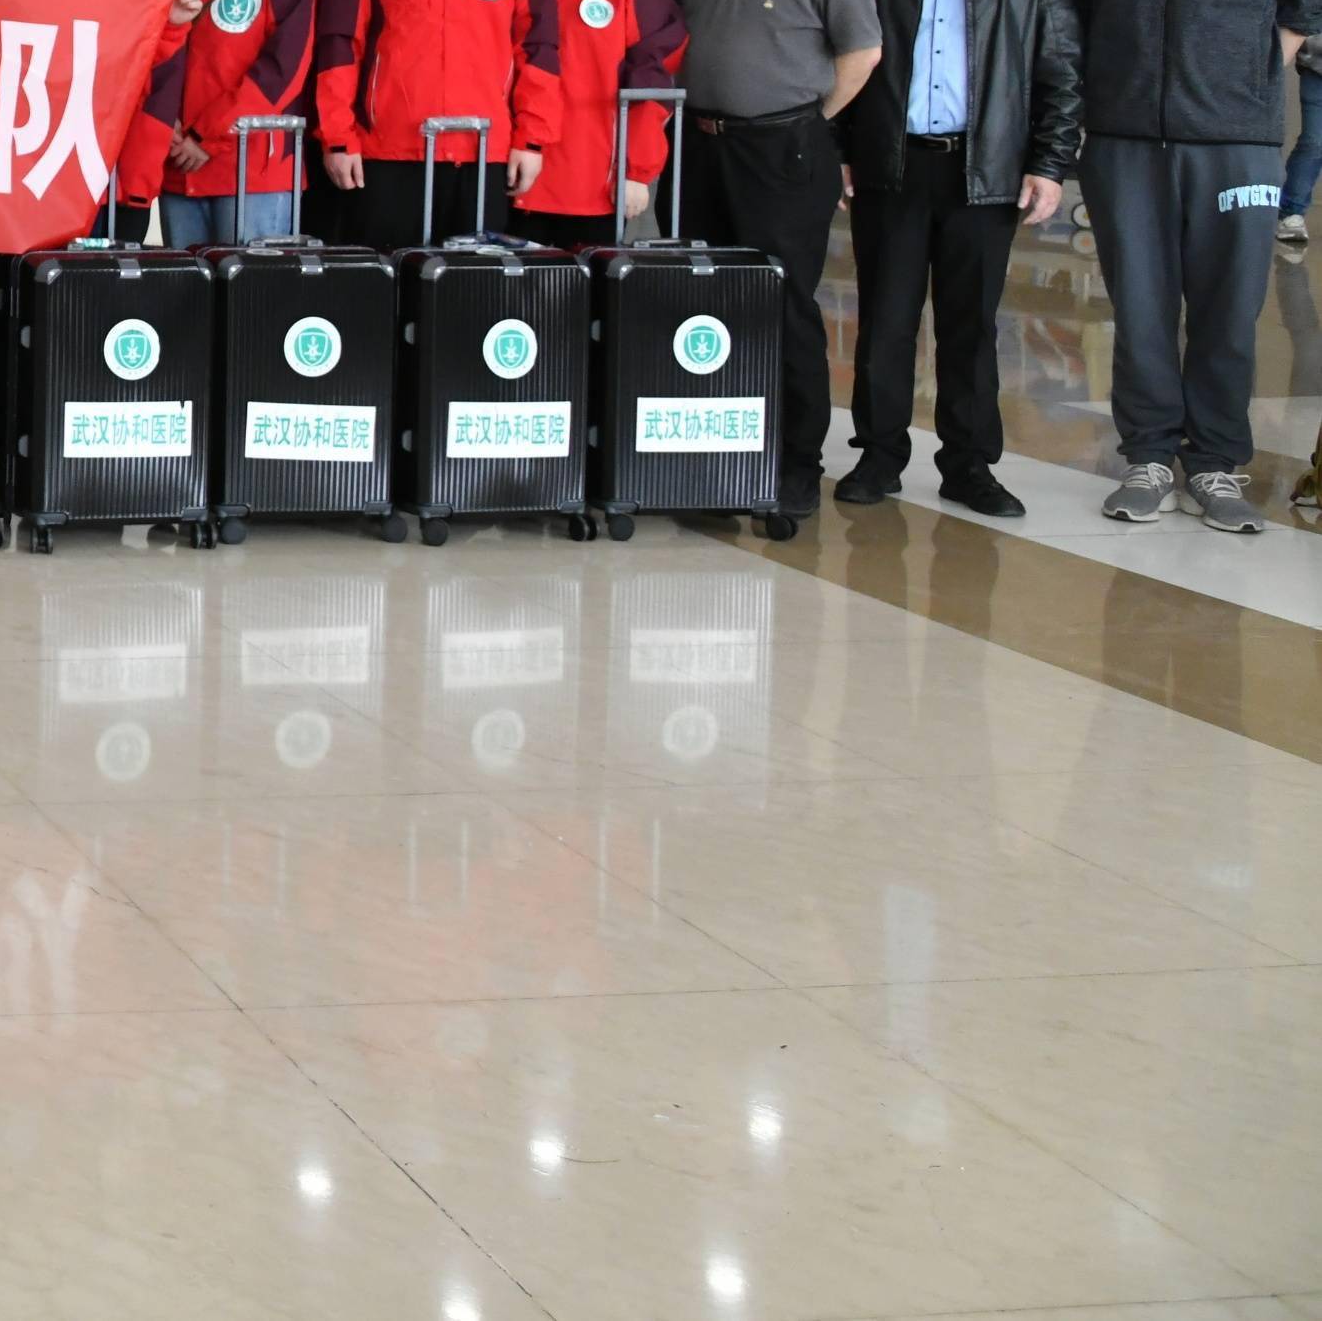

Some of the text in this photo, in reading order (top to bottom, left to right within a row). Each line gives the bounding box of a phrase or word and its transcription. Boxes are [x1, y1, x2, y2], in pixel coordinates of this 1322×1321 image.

[70, 413, 188, 445] 武汉协和医院
[252, 416, 372, 449] 武汉协和医院
[455, 413, 566, 446] 武汉协和医院
[643, 409, 760, 440] 武汉协和医院
